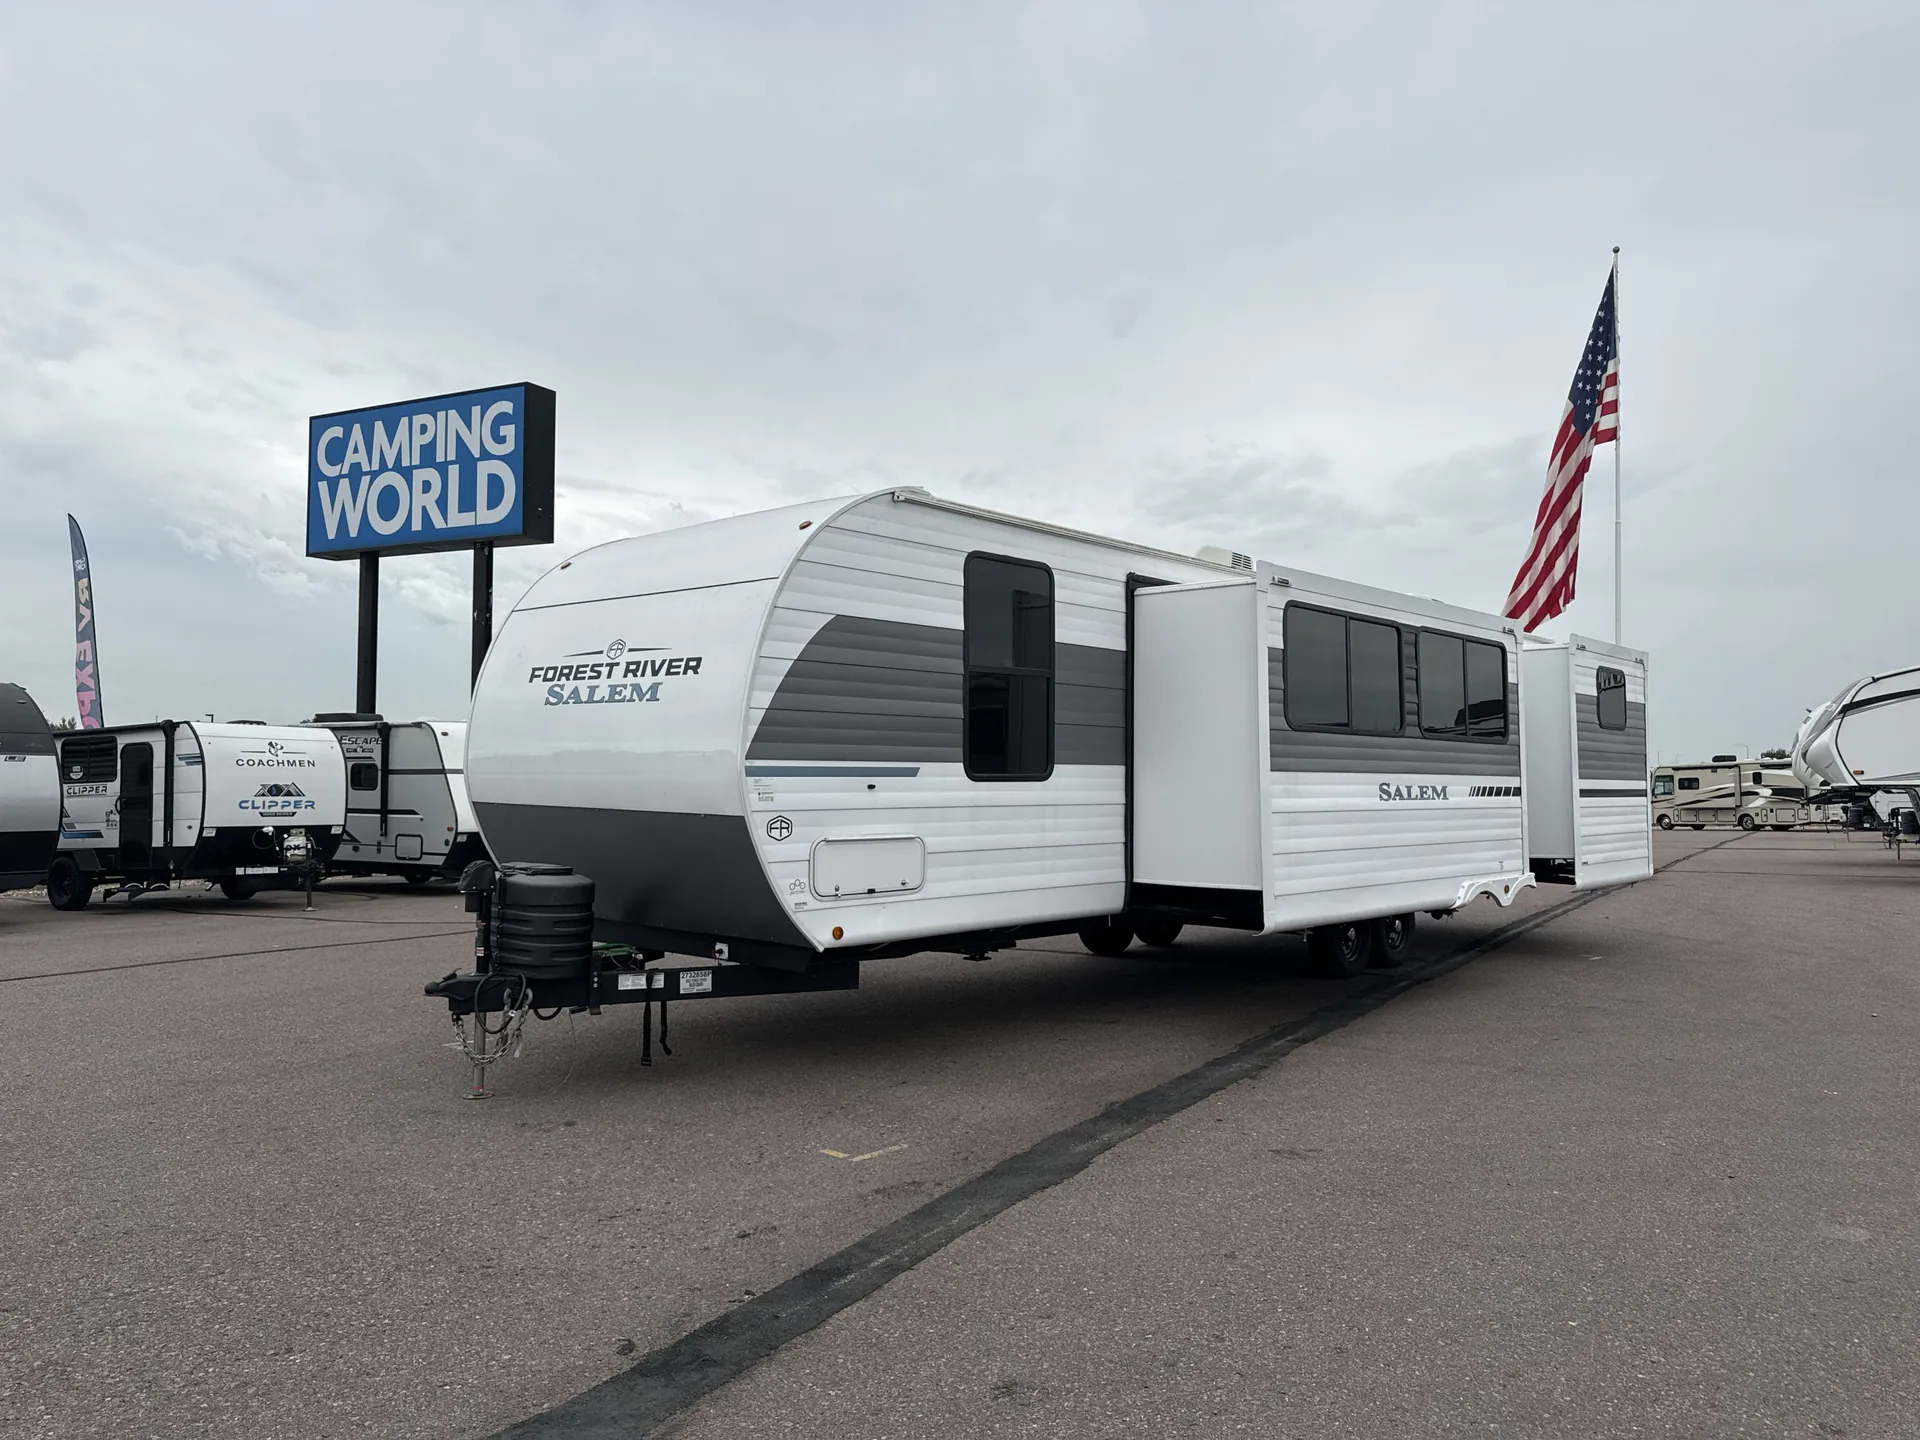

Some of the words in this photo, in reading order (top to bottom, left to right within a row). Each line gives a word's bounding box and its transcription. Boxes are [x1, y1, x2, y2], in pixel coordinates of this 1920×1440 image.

[317, 400, 516, 477] CAMPING
[317, 459, 516, 540] WORLD
[528, 661, 620, 683] FOREST
[622, 656, 703, 679] RIVER
[544, 681, 663, 706] SALEM
[340, 735, 382, 745] ESCAPE
[235, 758, 316, 768] COACHMEN
[66, 785, 108, 795] CLIPPER
[1378, 782, 1450, 802] SALEM
[238, 799, 316, 810] CLIPPER
